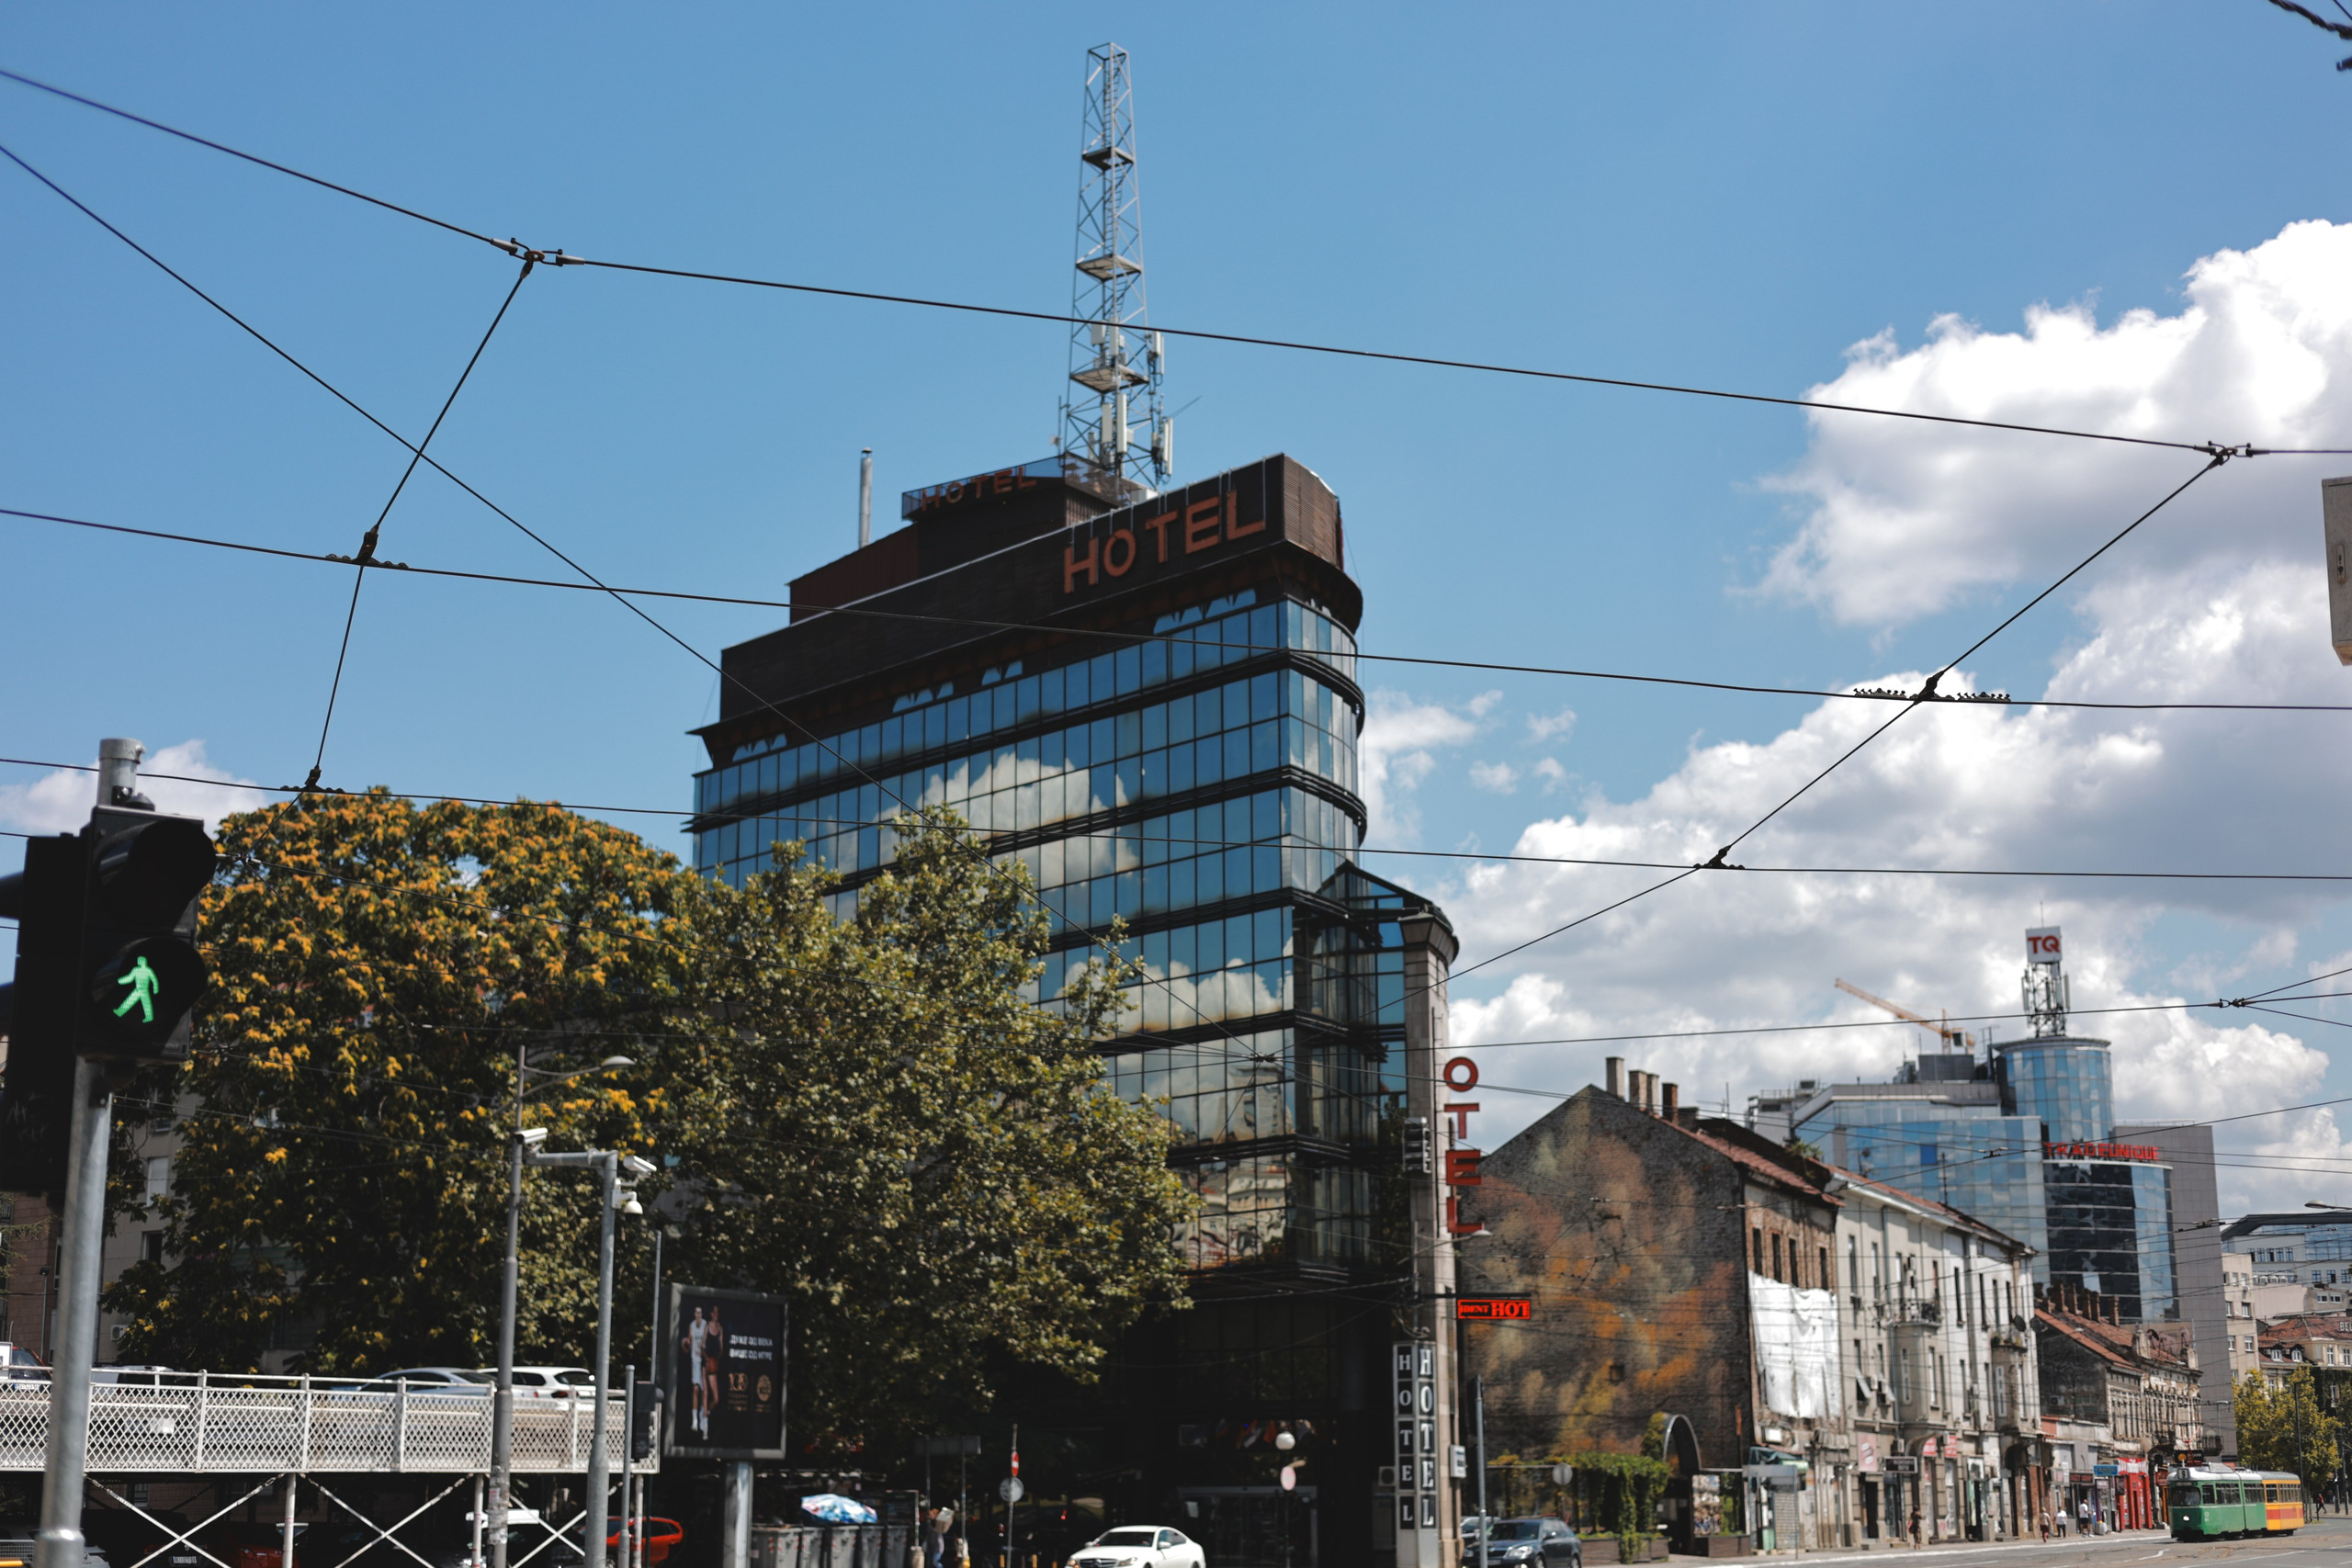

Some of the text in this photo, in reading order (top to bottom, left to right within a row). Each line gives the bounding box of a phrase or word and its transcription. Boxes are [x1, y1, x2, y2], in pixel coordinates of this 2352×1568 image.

[921, 466, 1037, 512] HOTEL
[1064, 490, 1266, 593] HOTEL
[2027, 935, 2060, 953] TQ
[1443, 1056, 1485, 1233] OTEL
[2043, 1142, 2160, 1161] TRADEUNIQUE
[1398, 1354, 1413, 1521] HOTEL
[1419, 1348, 1434, 1526] HOTEL
[2181, 1470, 2187, 1478] 9
